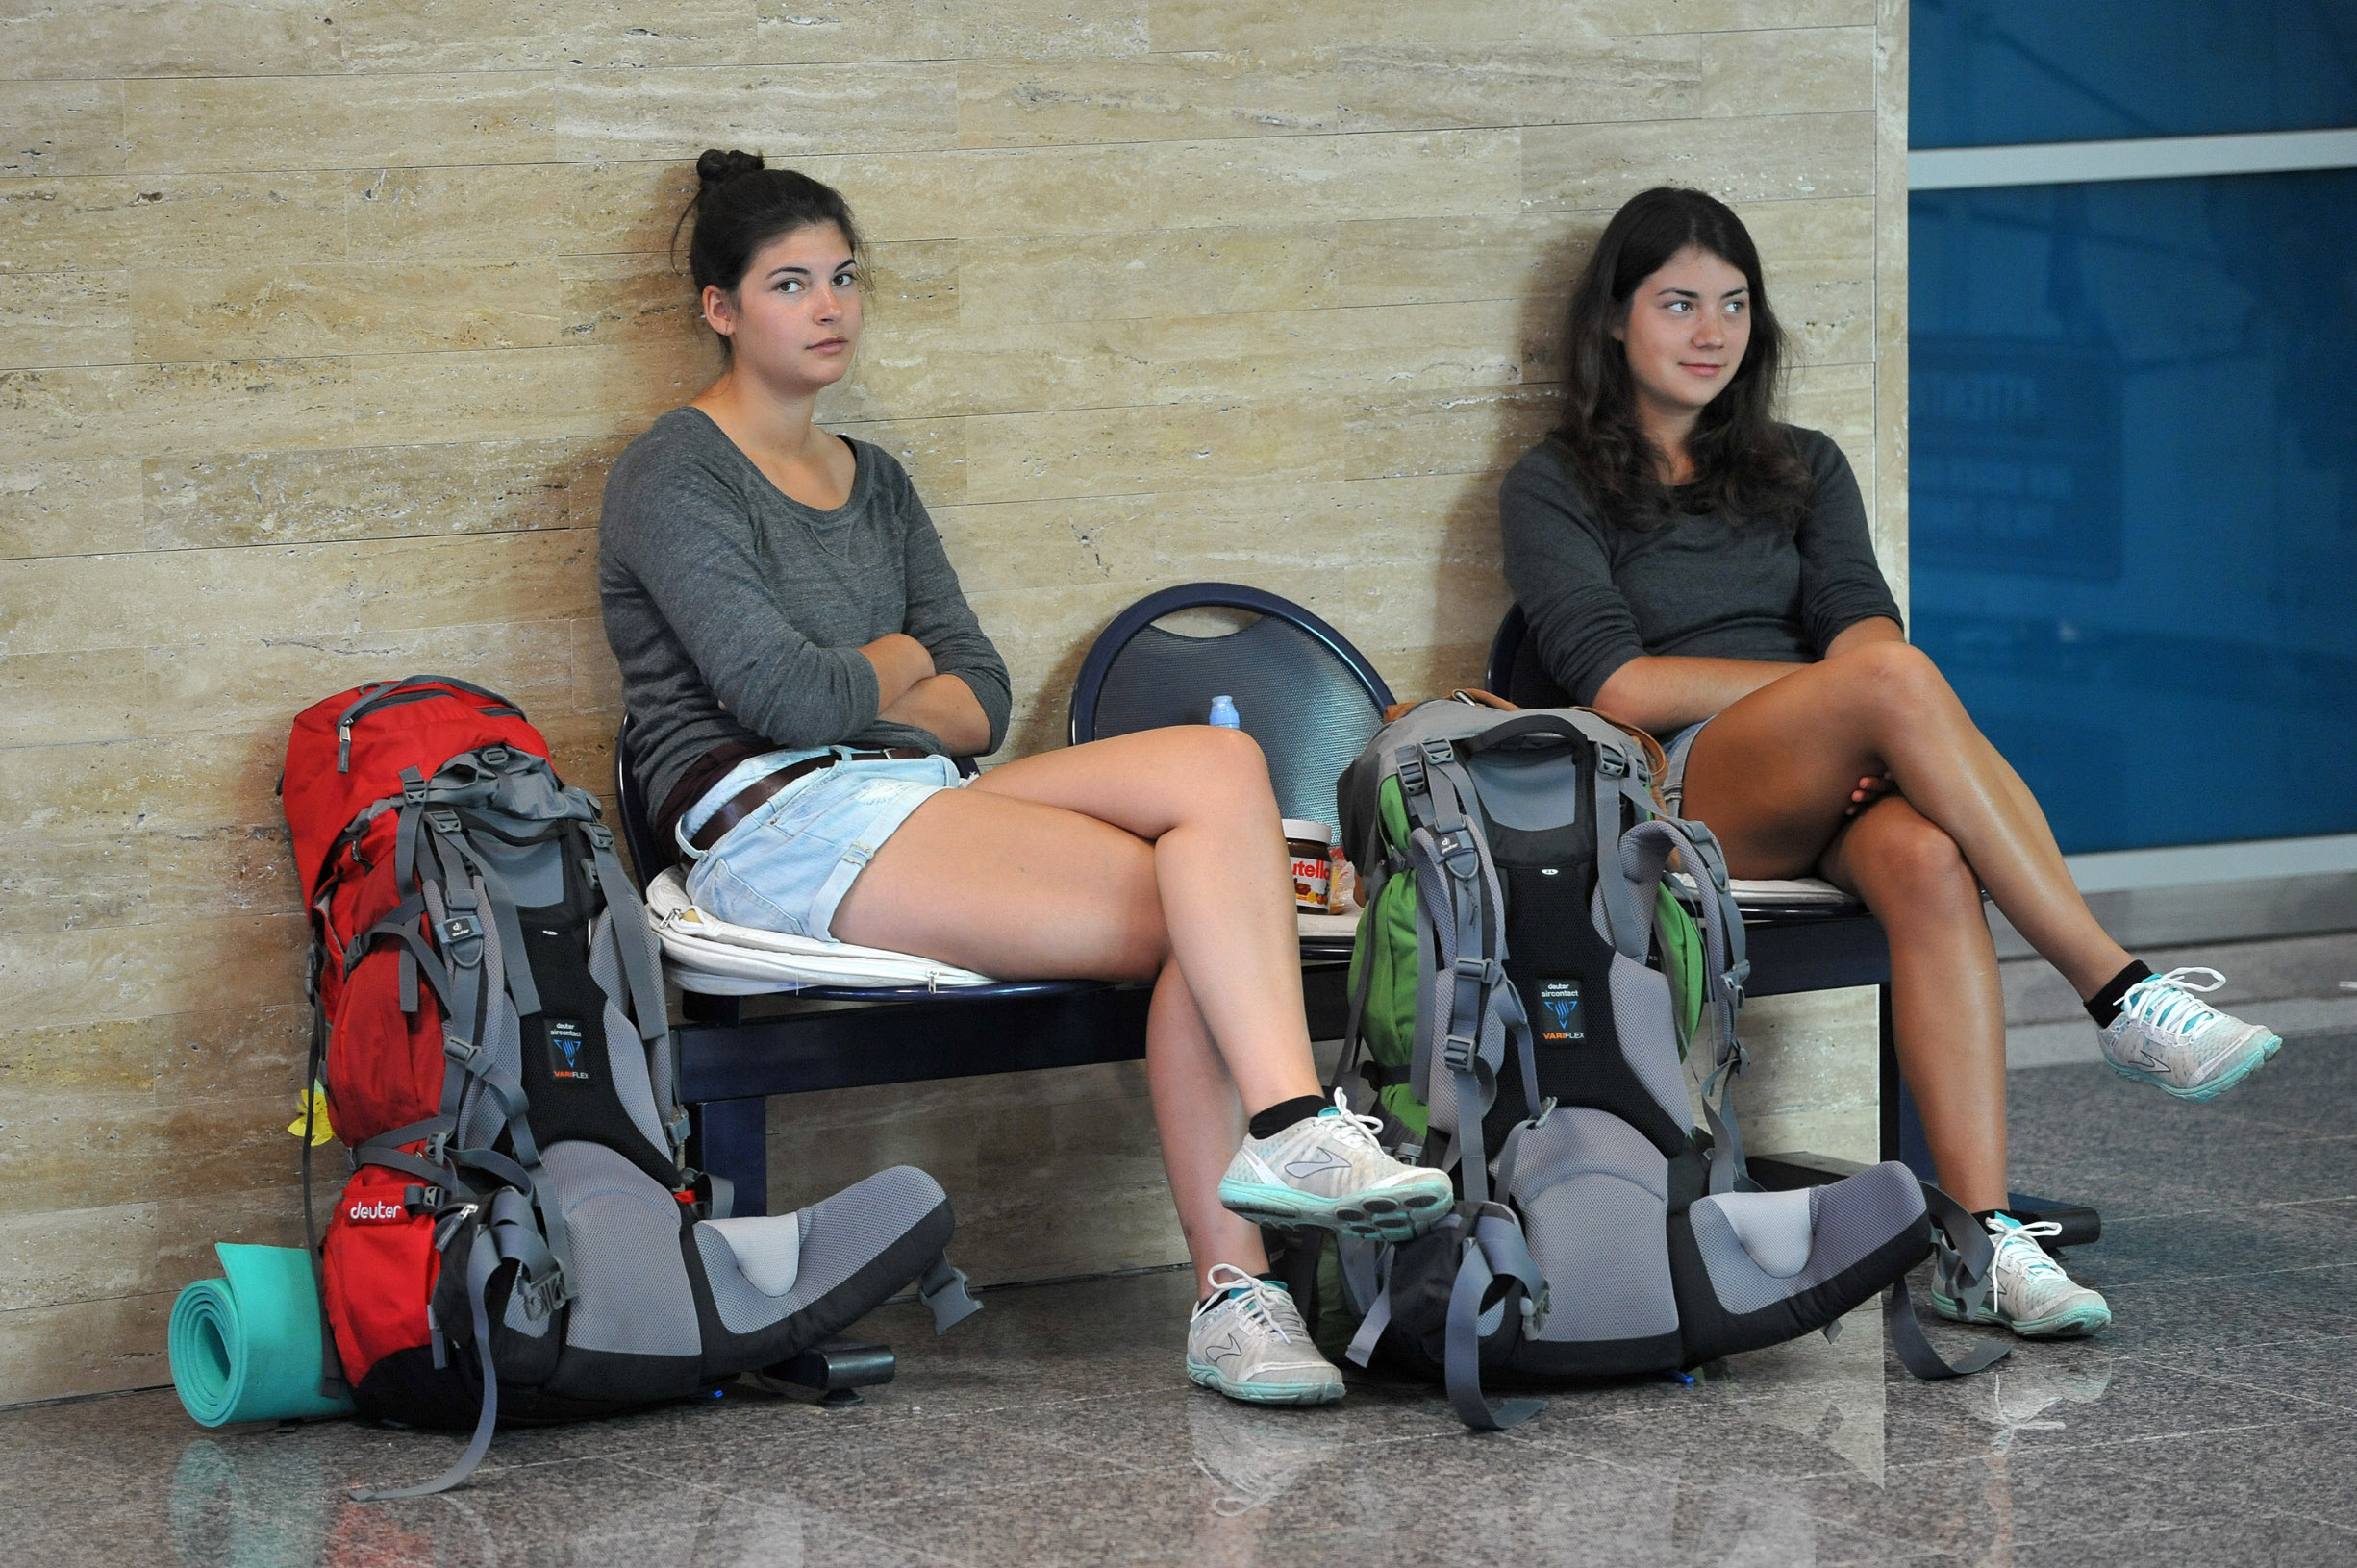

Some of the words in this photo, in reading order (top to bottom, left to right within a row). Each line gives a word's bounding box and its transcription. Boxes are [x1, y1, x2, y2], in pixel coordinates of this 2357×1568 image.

[1441, 843, 1459, 854] deuter
[451, 929, 470, 937] deuter
[1541, 989, 1580, 998] aircontact
[549, 1028, 582, 1038] aircontact
[1543, 1032, 1585, 1040] VARIFLEX
[553, 1071, 589, 1080] VARIFLEX
[350, 1200, 401, 1219] deuter
